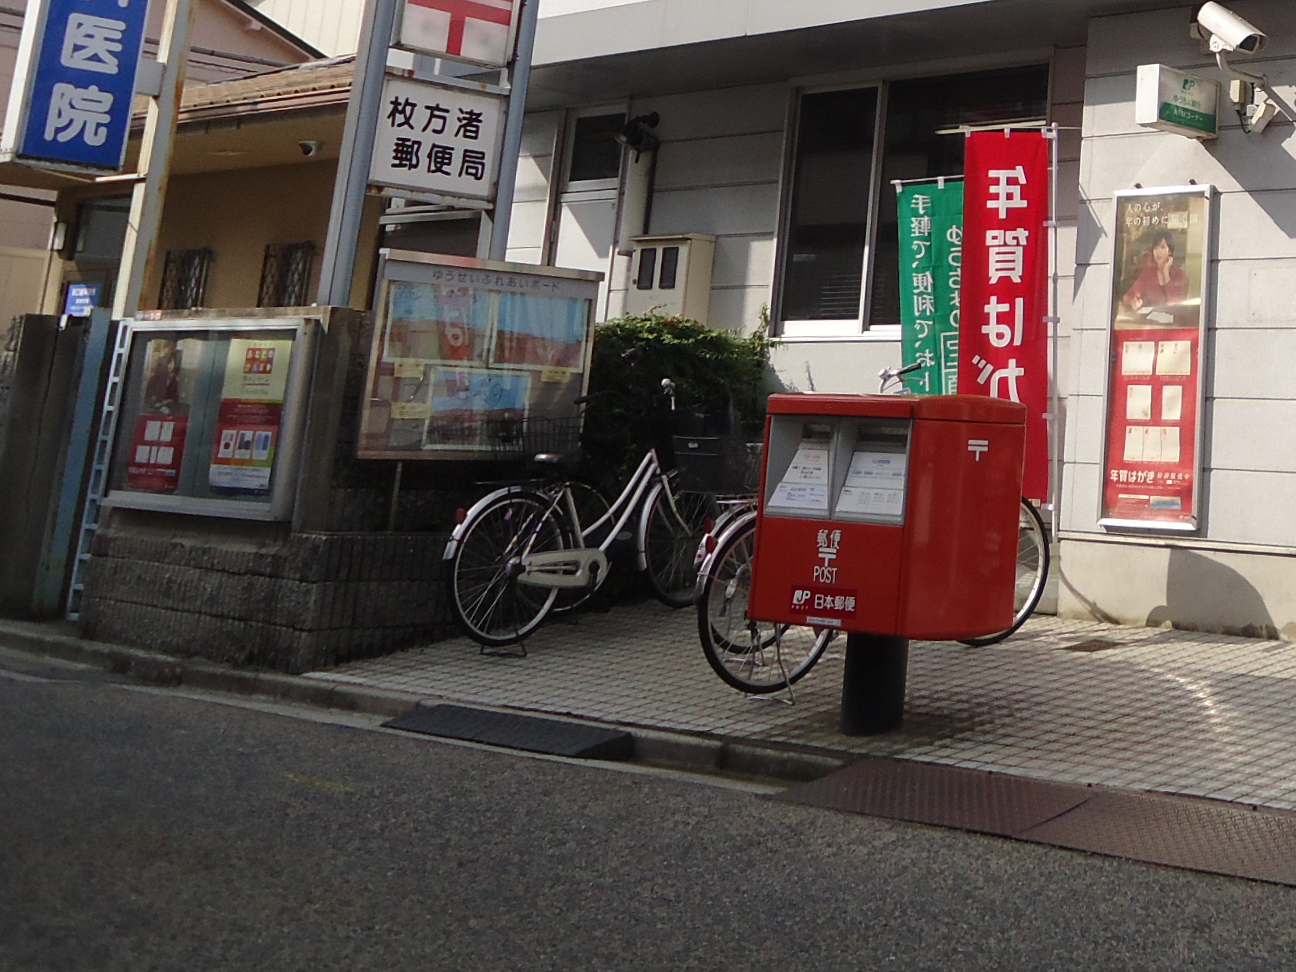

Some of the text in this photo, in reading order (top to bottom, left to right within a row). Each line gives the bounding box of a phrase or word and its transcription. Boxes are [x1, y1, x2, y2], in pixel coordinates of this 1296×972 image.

[386, 95, 484, 141] 枚方渚
[389, 136, 487, 181] 郵便局
[432, 269, 561, 293] ゆうせいふれあいボード
[1110, 469, 1156, 484] 年賀はがき
[816, 528, 843, 551] 郵便
[812, 565, 838, 585] POST
[793, 589, 812, 606] JP
[814, 593, 857, 613] 日本郵便
